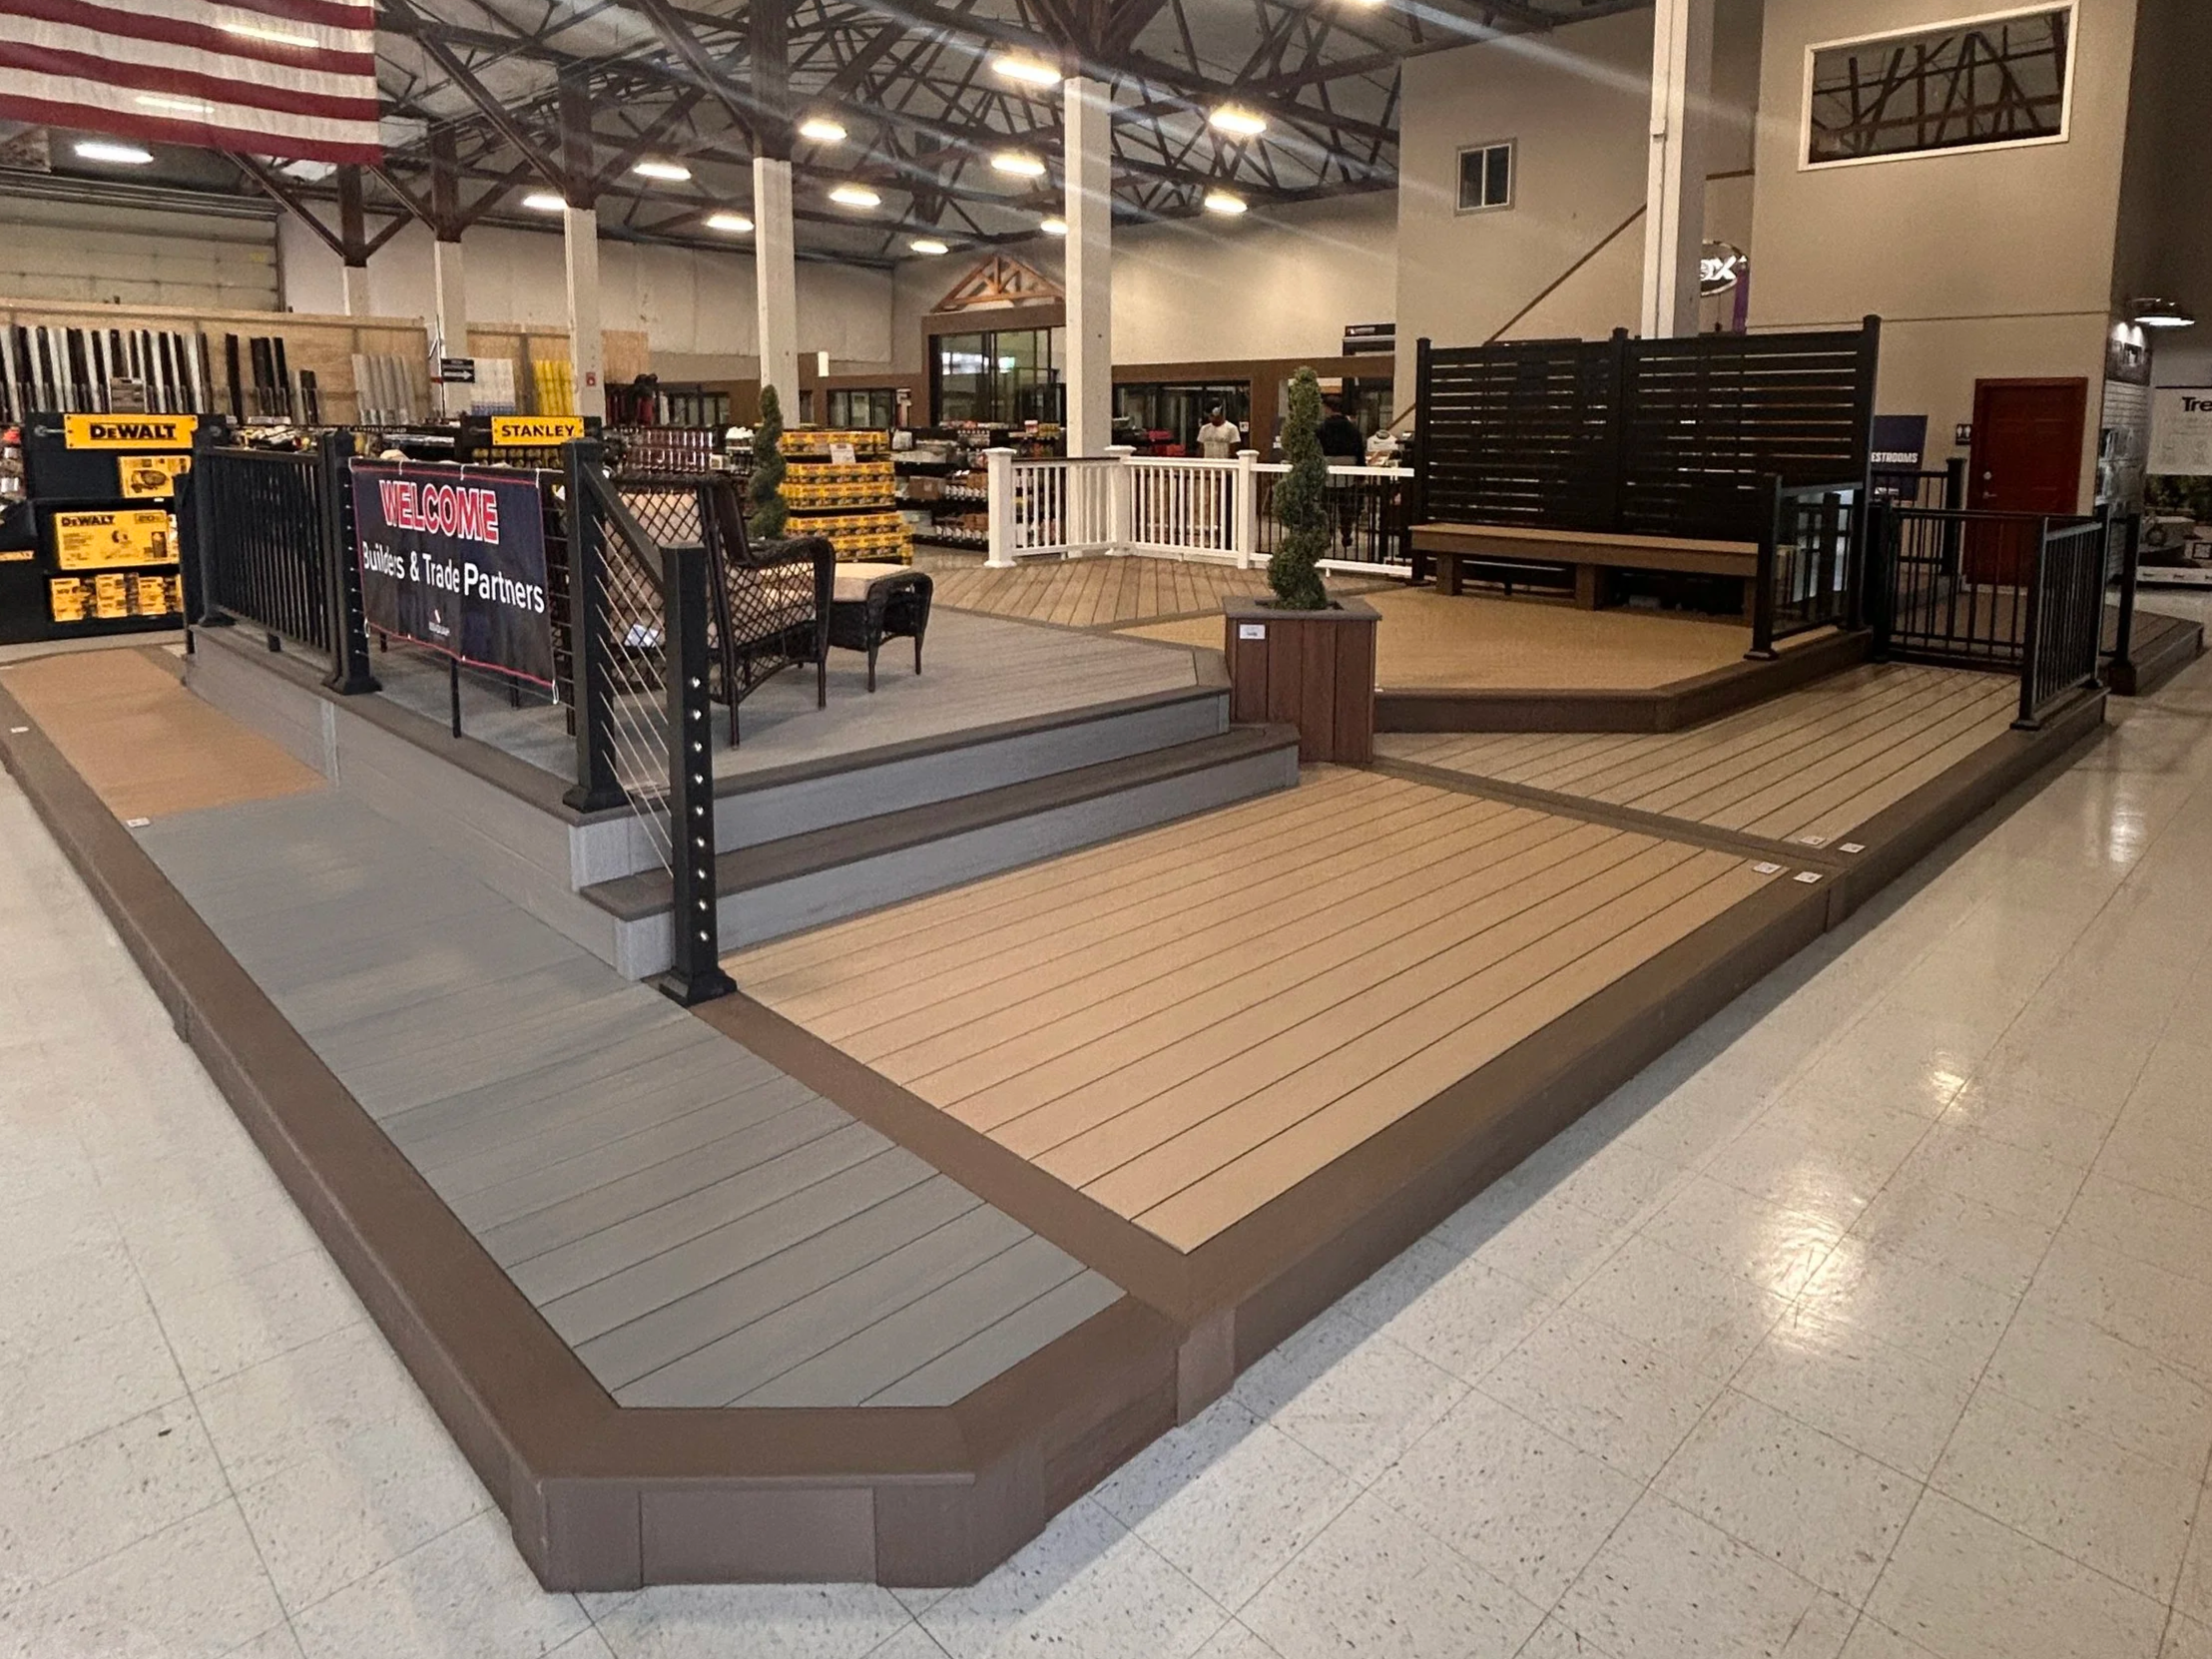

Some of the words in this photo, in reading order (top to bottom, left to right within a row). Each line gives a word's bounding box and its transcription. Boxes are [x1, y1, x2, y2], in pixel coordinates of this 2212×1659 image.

[2181, 396, 2212, 412] Tre
[501, 424, 575, 437] STANLEY
[1871, 452, 1919, 463] ESTROOMS
[378, 479, 499, 545] WELCOME
[362, 540, 406, 580] Builders
[409, 550, 420, 582] &
[422, 553, 460, 593] Trade
[464, 562, 546, 614] Partners
